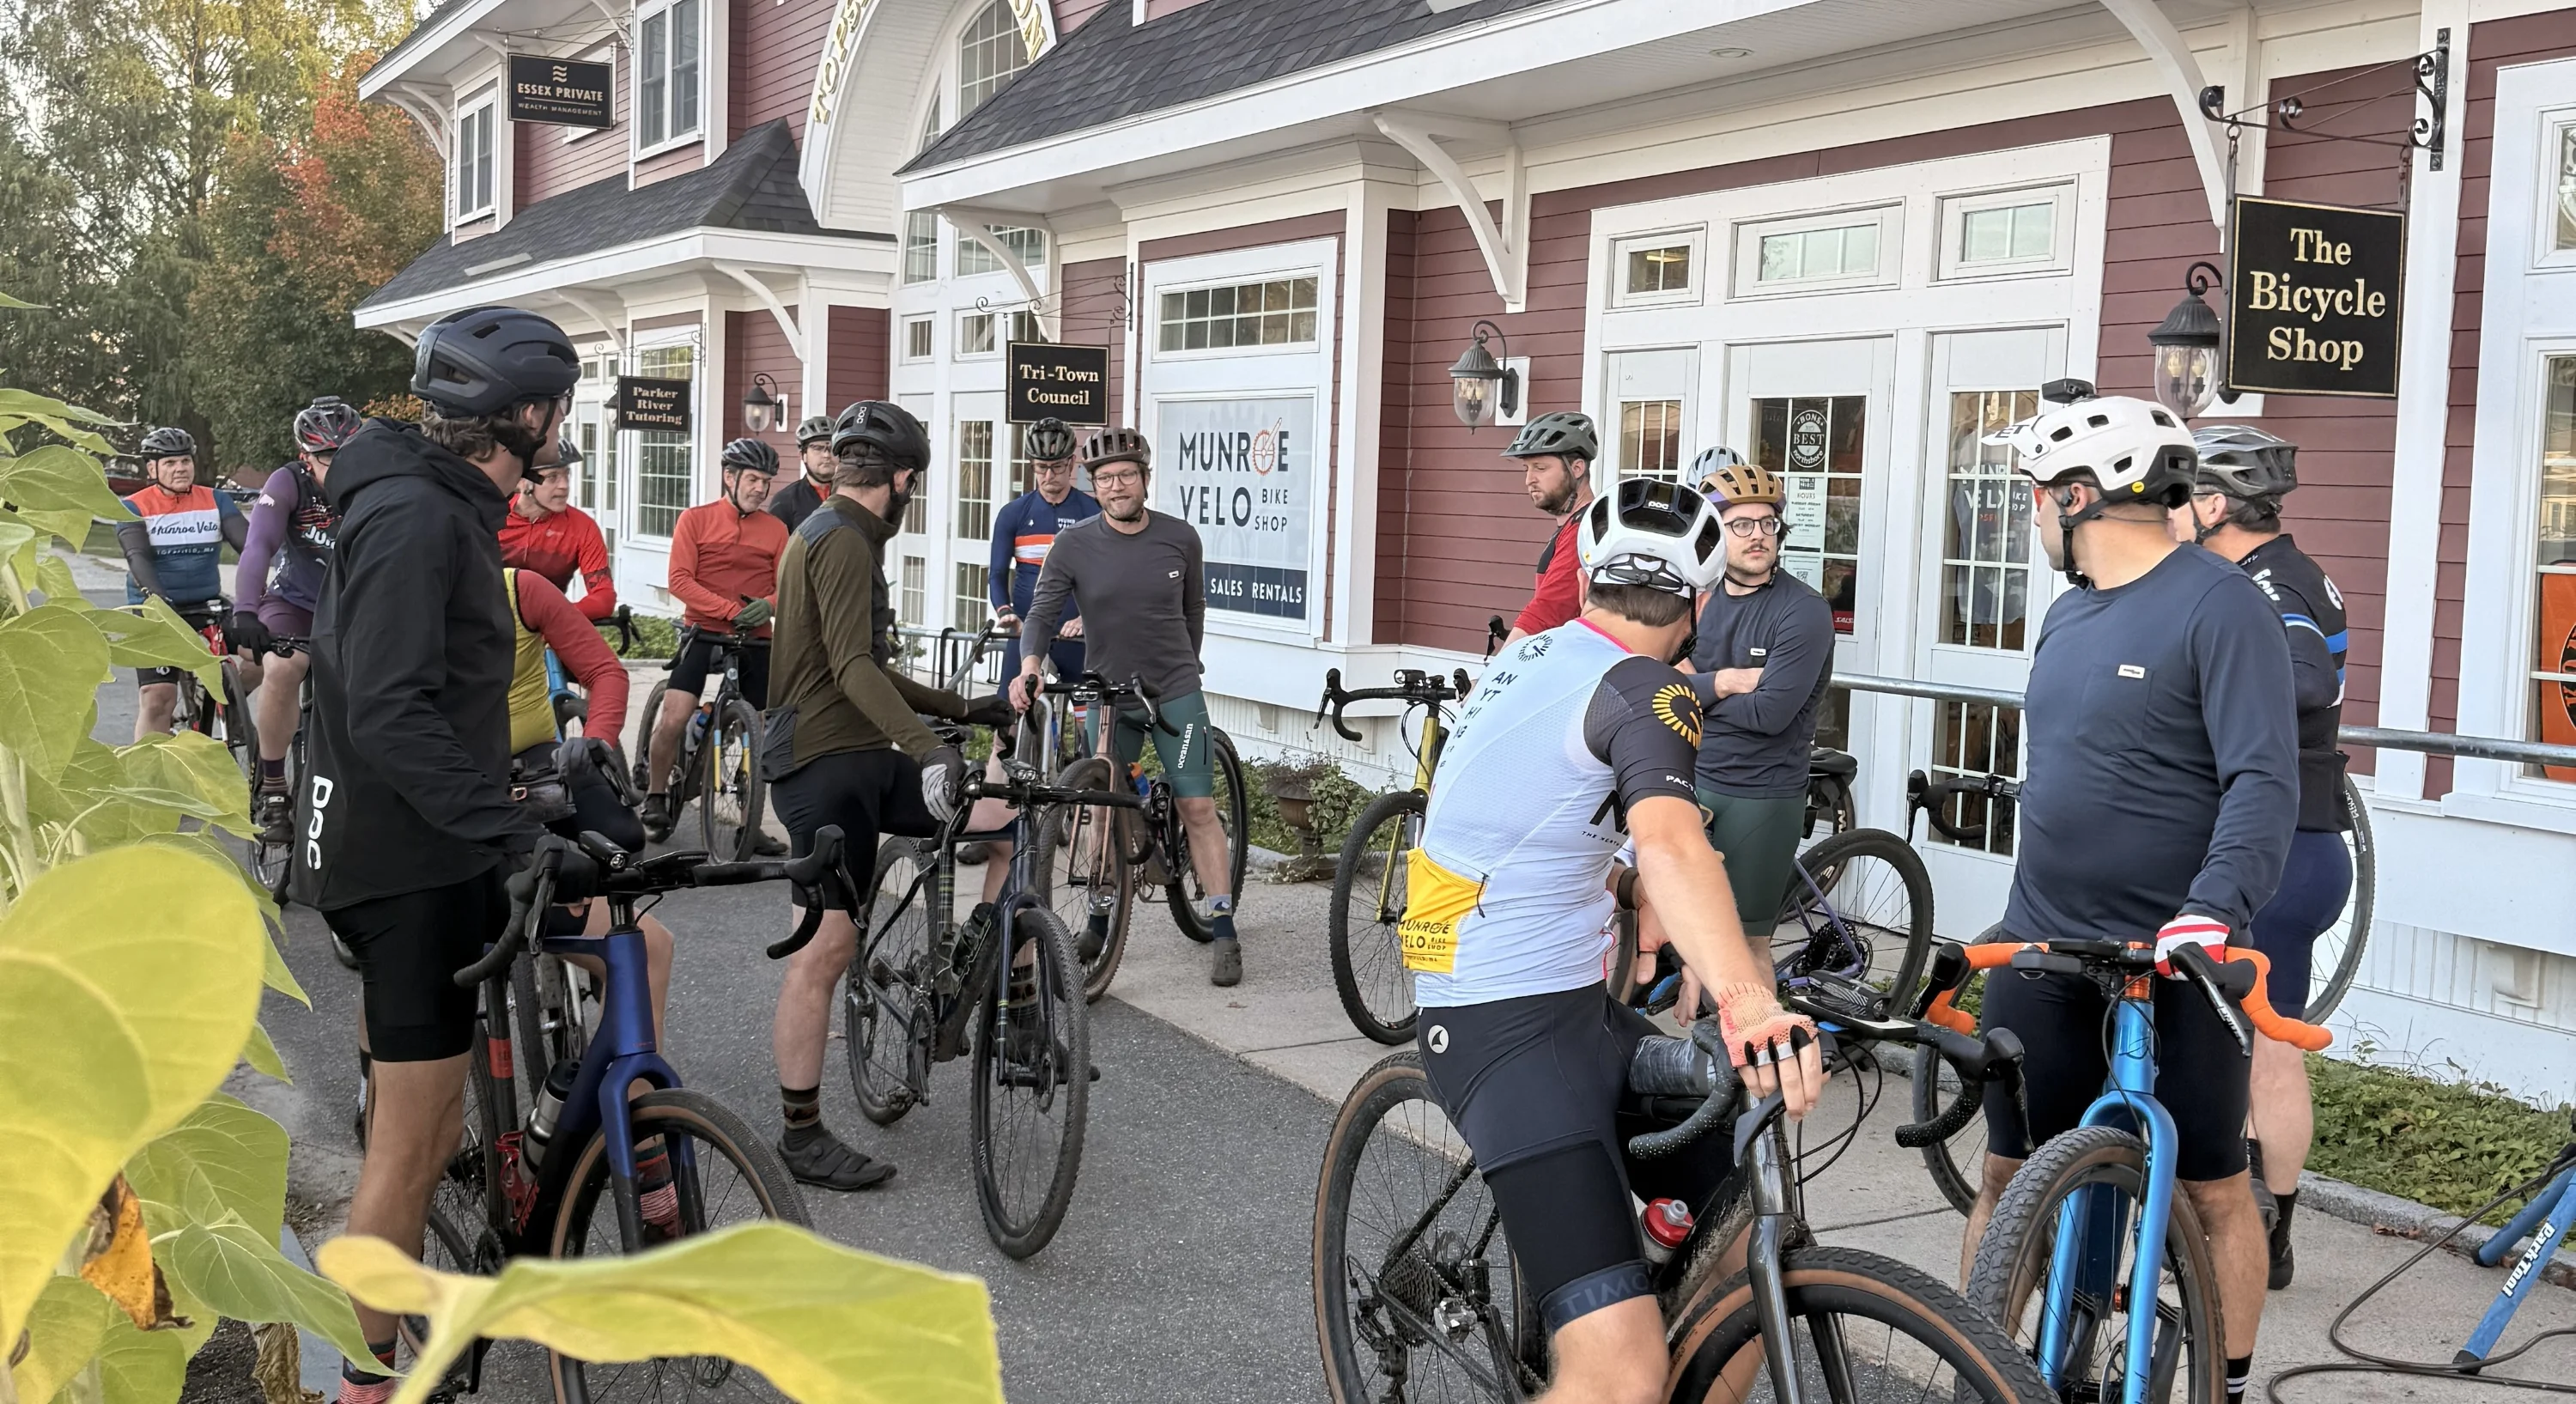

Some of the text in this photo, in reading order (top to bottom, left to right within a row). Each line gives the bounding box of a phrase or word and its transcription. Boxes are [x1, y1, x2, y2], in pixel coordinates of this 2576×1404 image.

[814, 0, 870, 125] TOPS
[518, 82, 603, 101] ESSEX PRIVATE
[551, 106, 602, 116] MANAGEMENT
[2290, 228, 2352, 265] The
[2248, 270, 2386, 322] Bicycle
[2268, 326, 2364, 370] Shop
[1019, 364, 1099, 382] Tri-Town
[633, 386, 678, 398] Parker
[1027, 387, 1090, 405] Council
[637, 399, 673, 410] River
[626, 410, 683, 425] Tutoring
[1794, 433, 1825, 445] BEST
[1179, 428, 1289, 476] MUNROE
[2012, 491, 2027, 501] IKE
[1180, 485, 1288, 527] VELO BIKE
[197, 520, 218, 534] Velo
[1255, 515, 1287, 532] SHOP
[1210, 578, 1302, 604] SALES RENTALS
[1666, 775, 1698, 799] PACT
